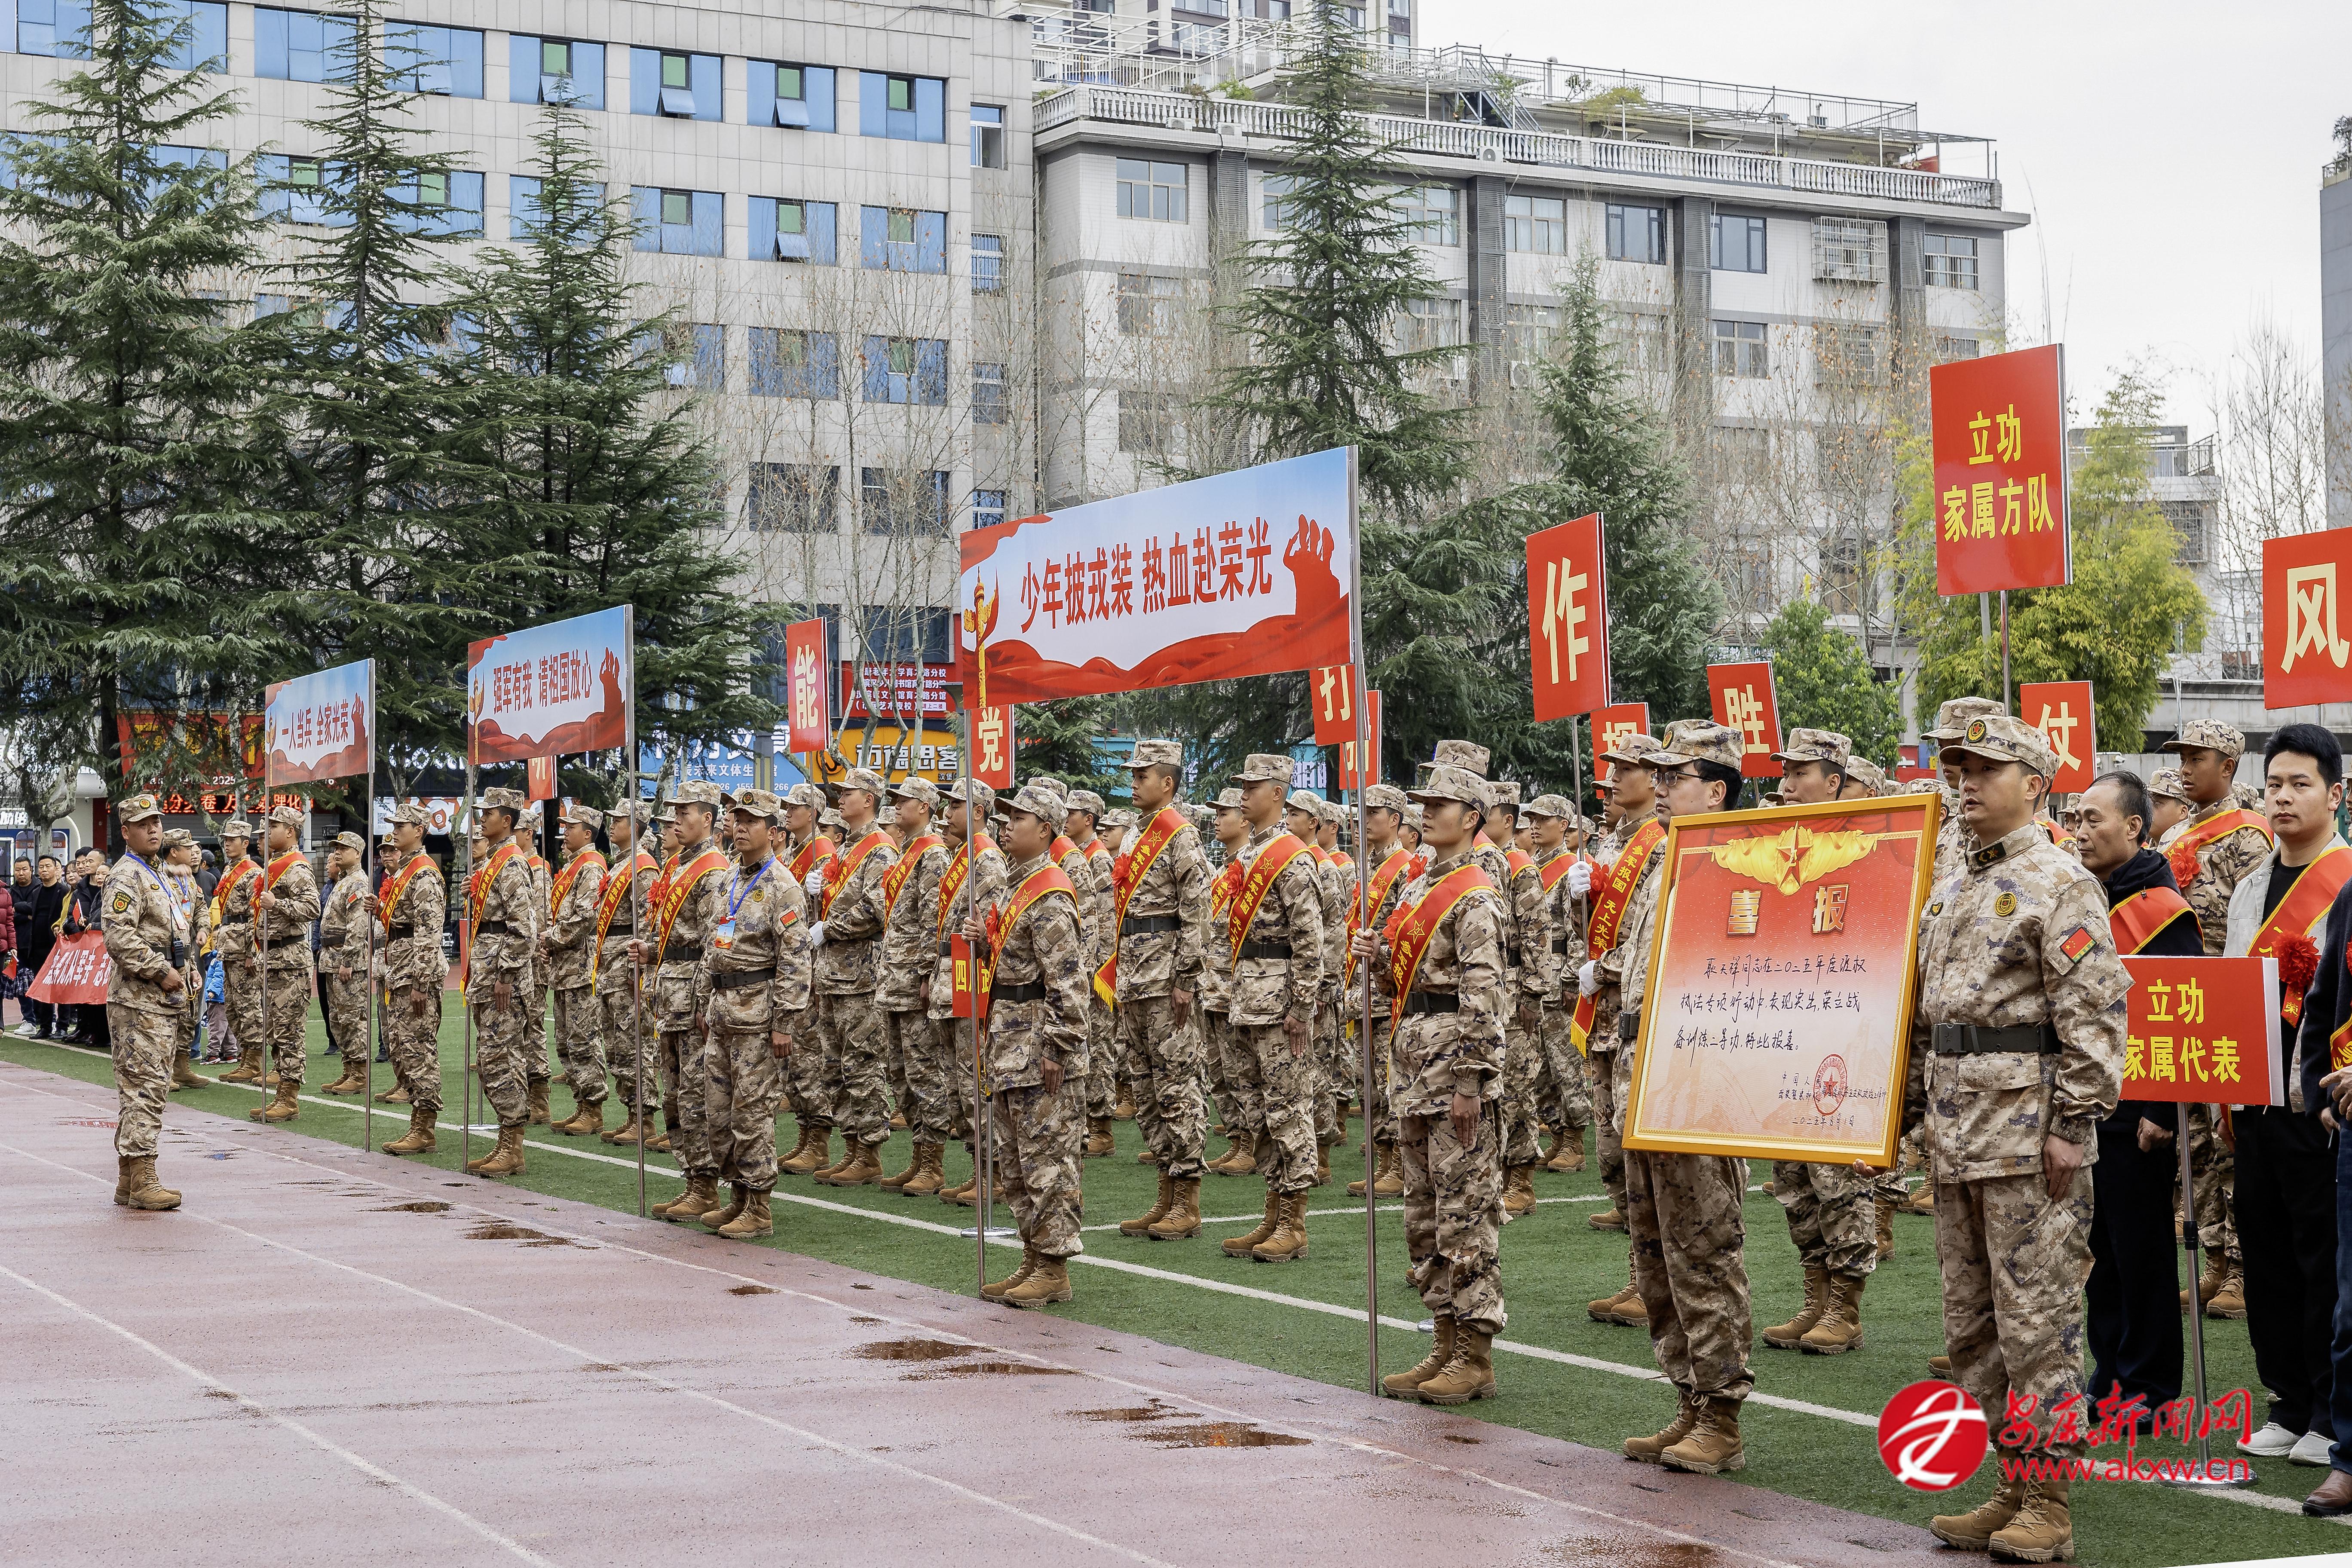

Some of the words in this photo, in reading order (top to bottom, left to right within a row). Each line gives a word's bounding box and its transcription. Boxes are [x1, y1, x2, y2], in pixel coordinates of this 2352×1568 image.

[1969, 403, 2022, 466] 立功
[1943, 472, 2055, 544] 家属方队
[1020, 542, 1133, 634] 少年披戎装
[1142, 516, 1272, 616] 热血赴荣光
[1541, 556, 1589, 685] 作
[2281, 562, 2351, 674] 风
[493, 659, 533, 714] 强军有我
[539, 649, 592, 707] 请祖国放心
[794, 643, 818, 730] 能
[1317, 665, 1351, 722] 打
[282, 706, 312, 751] 一人当兵
[316, 698, 349, 746] 全家光荣
[978, 707, 1005, 773] 党
[1723, 684, 1771, 754] 胜
[2038, 702, 2082, 772] 仗
[1240, 872, 1264, 915] 参军报国
[1611, 845, 1644, 894] 参军报国
[1592, 899, 1617, 952] 无上光荣
[1727, 884, 1850, 936] 喜报
[2147, 977, 2204, 1025] 立功
[2122, 1035, 2242, 1084] 家属代表
